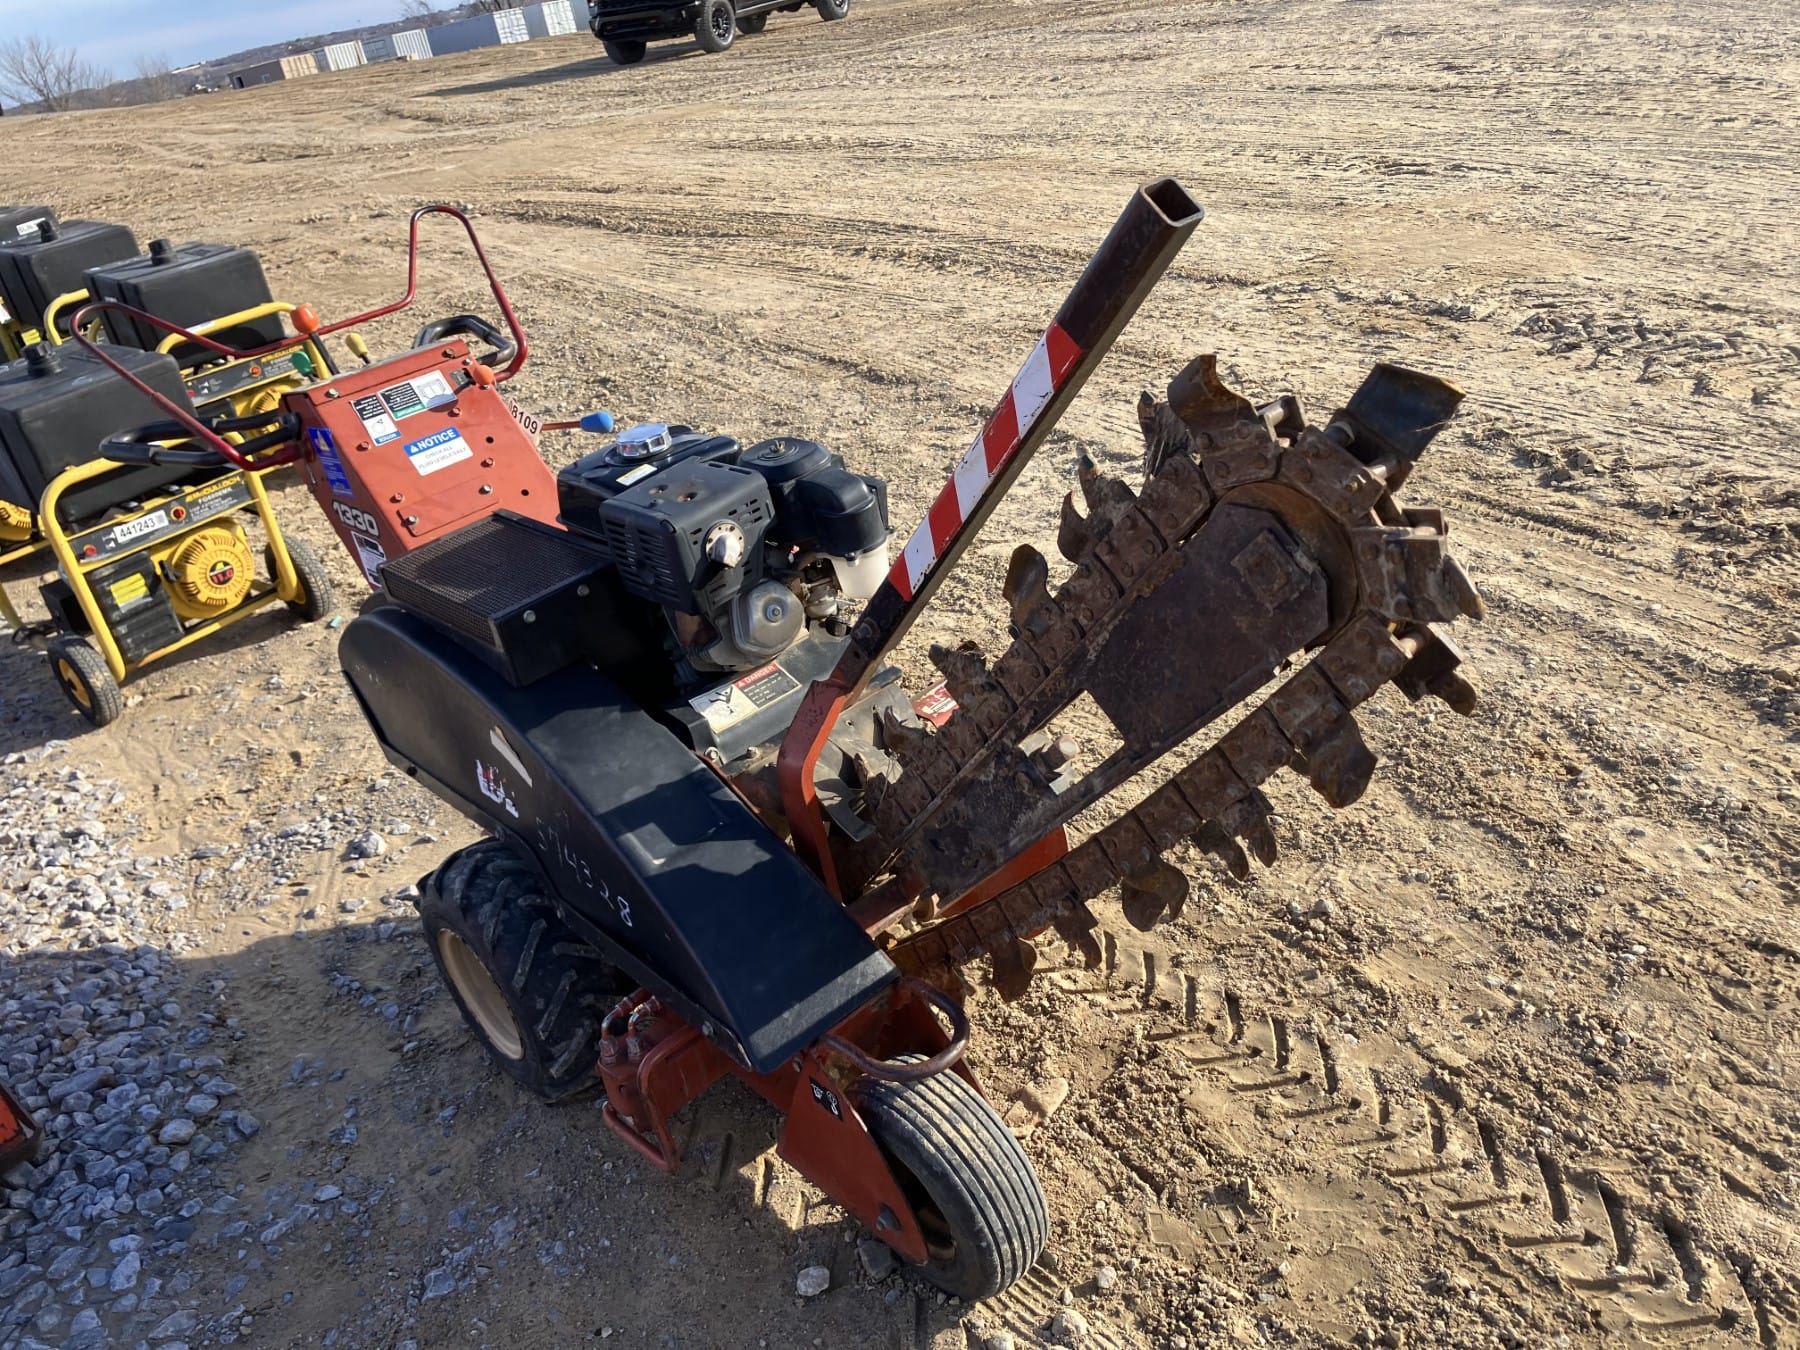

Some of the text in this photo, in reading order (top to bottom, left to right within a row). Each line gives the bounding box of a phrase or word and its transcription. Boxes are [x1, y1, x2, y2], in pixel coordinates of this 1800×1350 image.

[416, 429, 456, 450] NOTICE
[119, 518, 156, 538] 441243
[332, 502, 379, 536] 1330
[744, 664, 776, 685] DANGER
